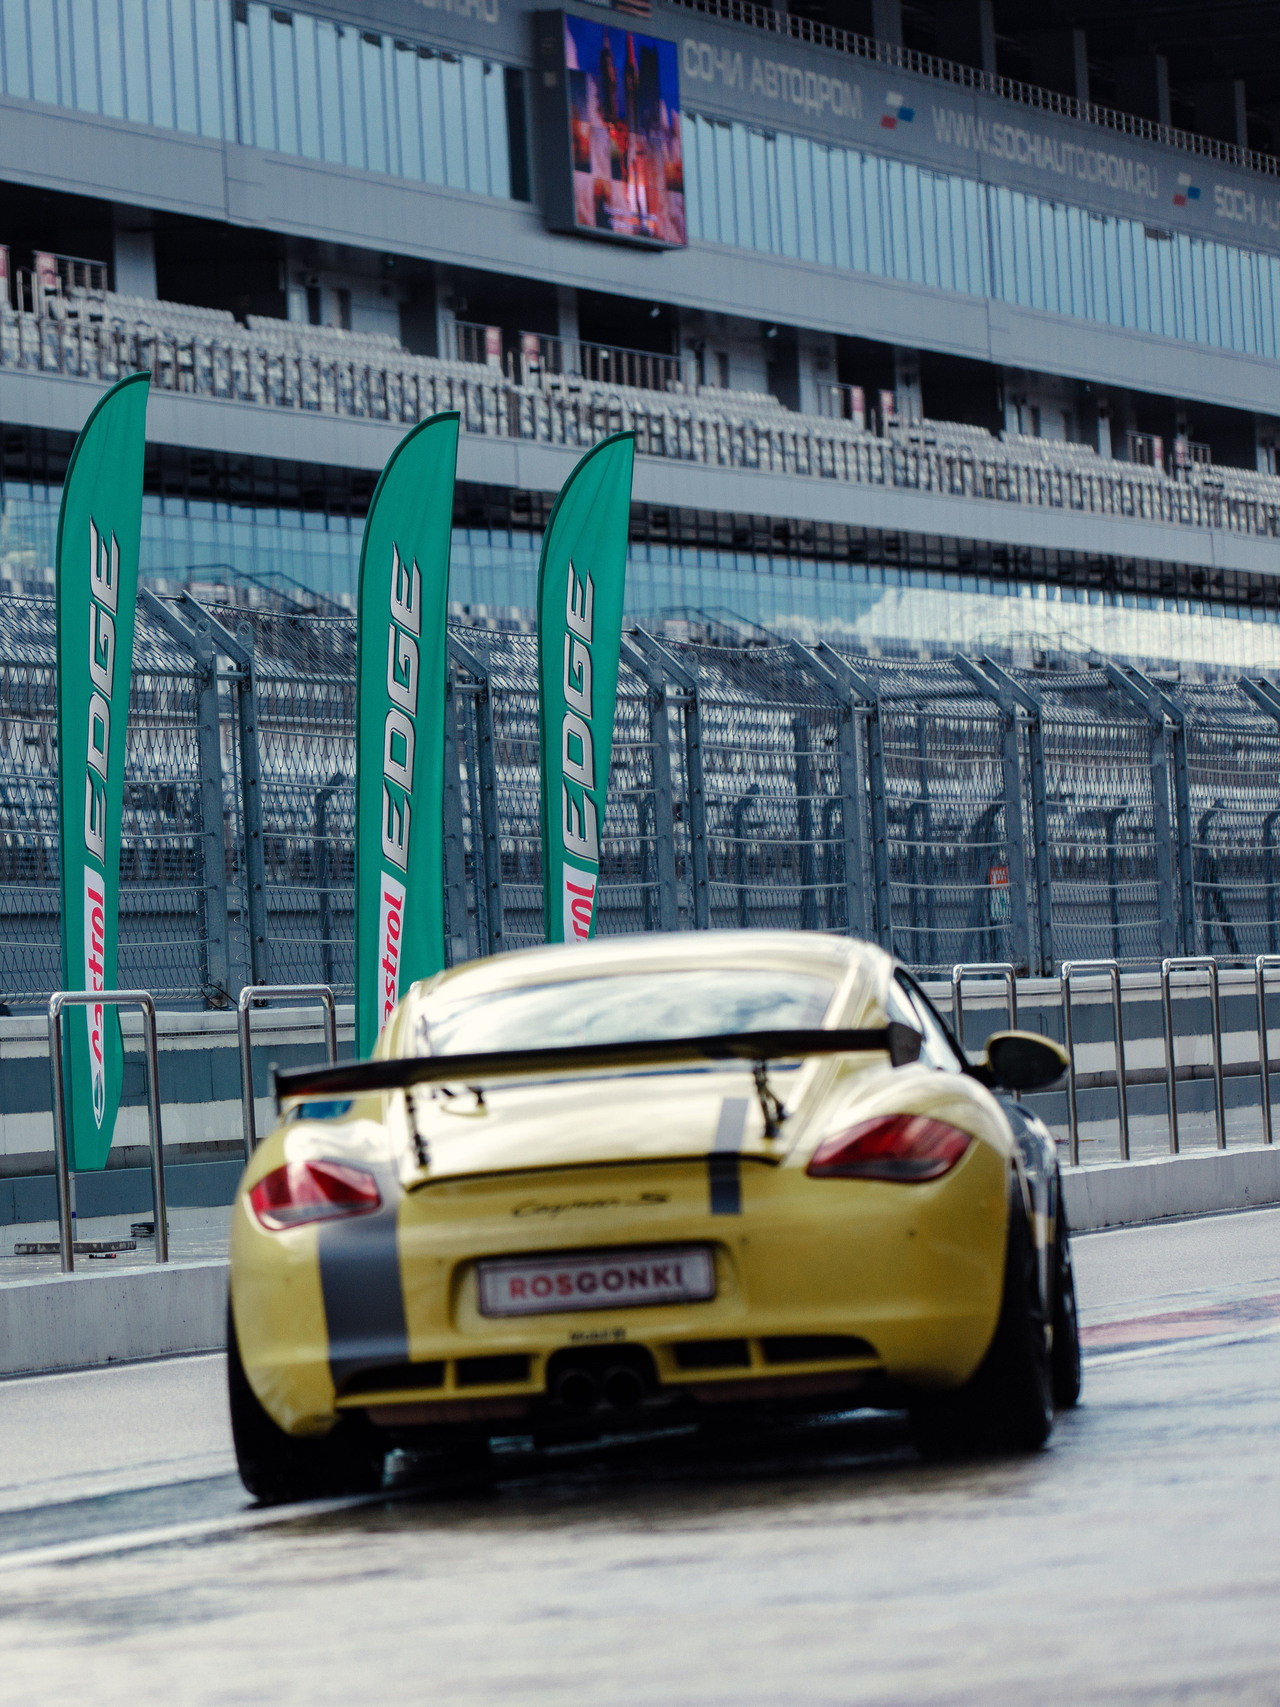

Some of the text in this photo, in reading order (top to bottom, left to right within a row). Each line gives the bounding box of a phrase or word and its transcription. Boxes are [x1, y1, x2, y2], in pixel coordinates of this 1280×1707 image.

[682, 38, 863, 120] СОЧИ АВТОДРОМ
[1214, 184, 1257, 226] SOCHI
[83, 513, 120, 867] EDGE
[381, 541, 422, 874] EDGE
[562, 556, 599, 864] EDGE
[508, 1264, 684, 1299] ROSGONKI
